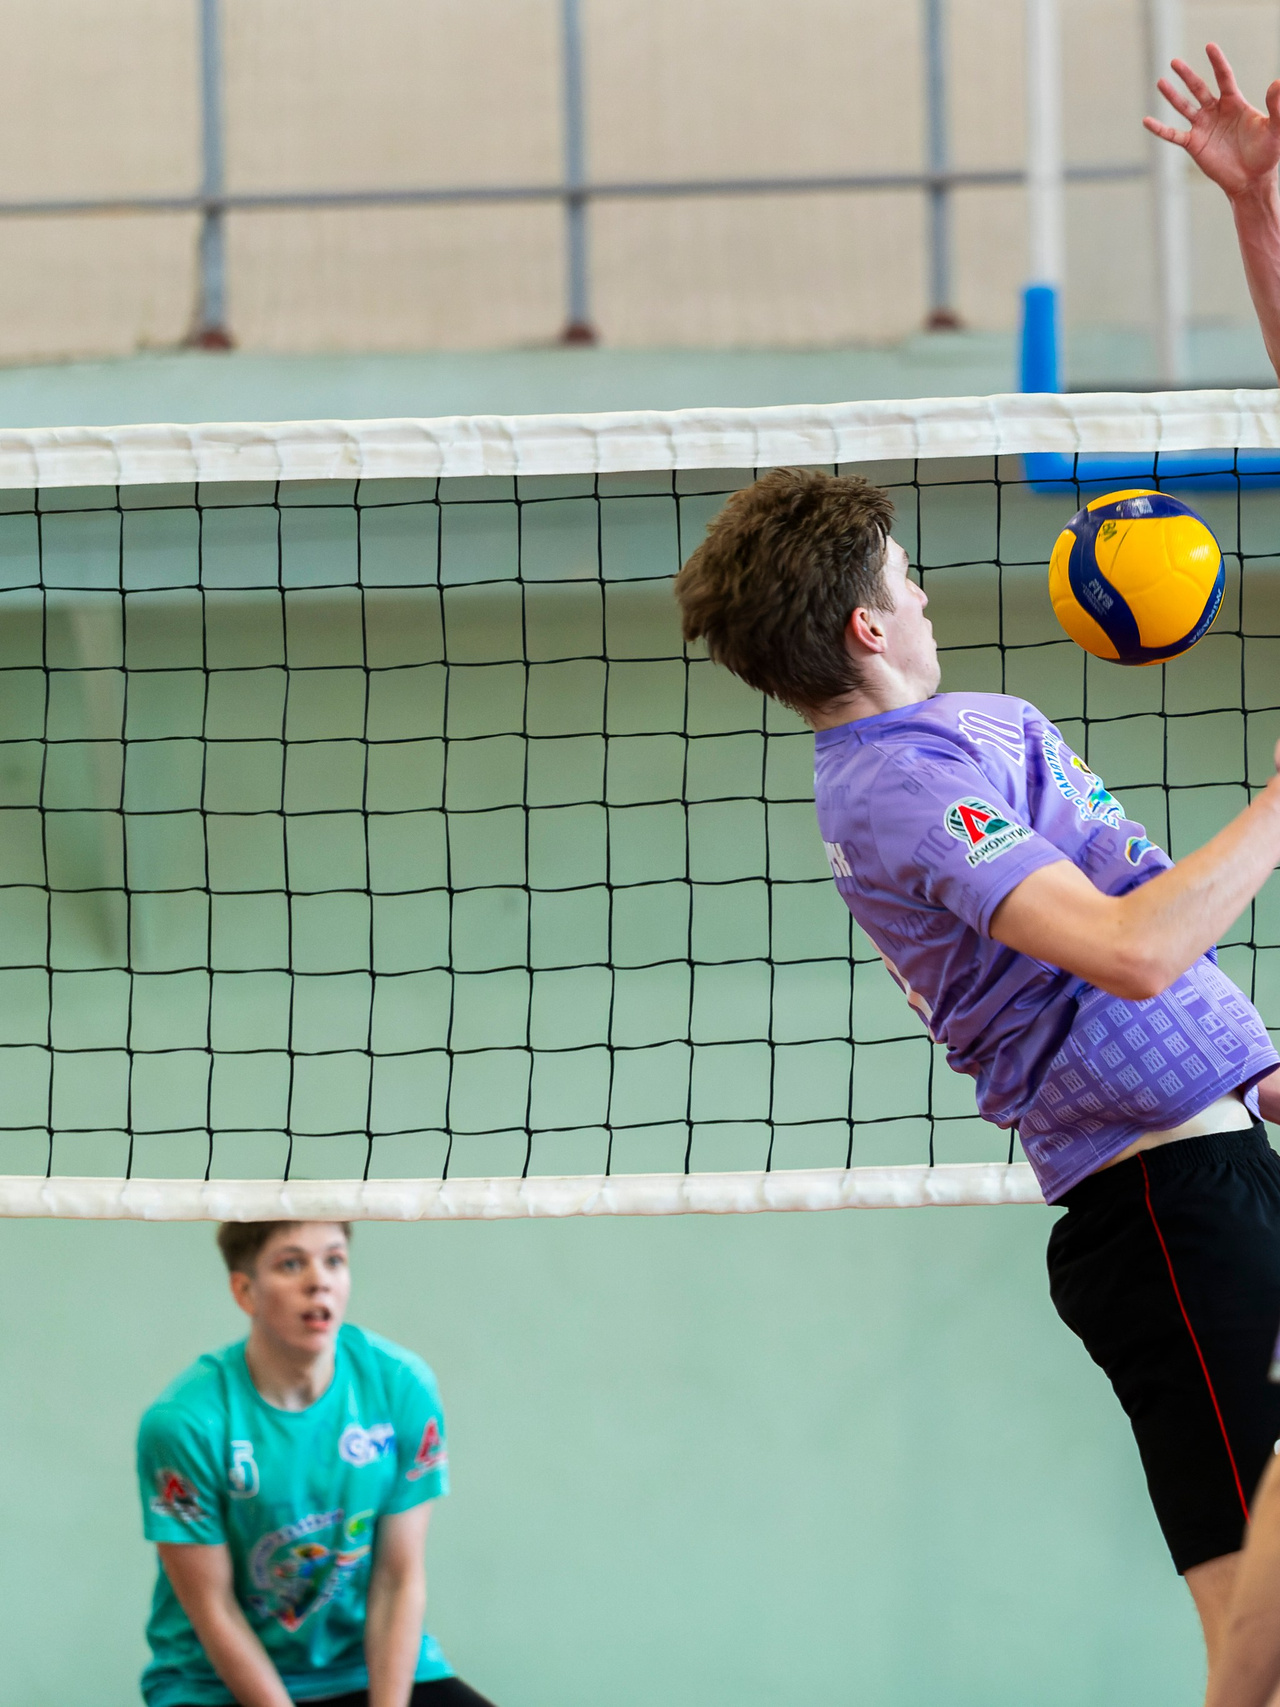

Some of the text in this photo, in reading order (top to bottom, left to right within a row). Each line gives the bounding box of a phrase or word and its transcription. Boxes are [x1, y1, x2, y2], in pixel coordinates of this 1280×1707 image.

[1088, 578, 1114, 610] FIVB
[958, 709, 1026, 767] 10
[1044, 747, 1080, 799] ПАМЯТИ
